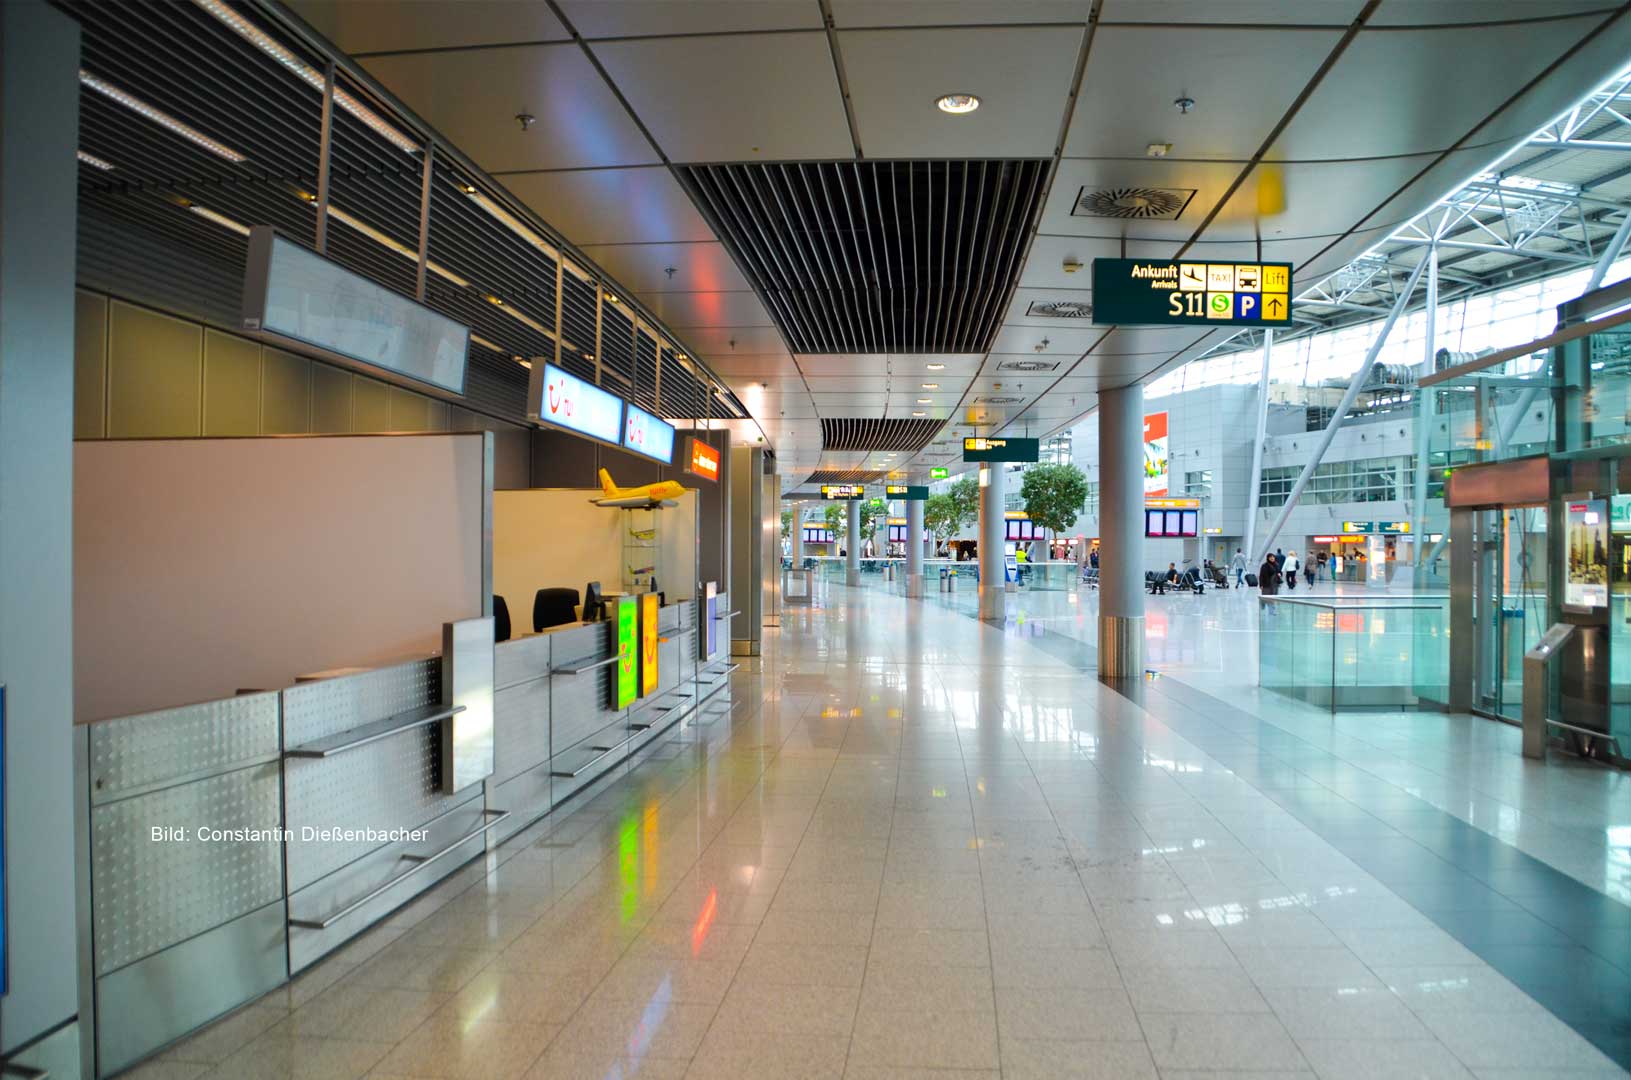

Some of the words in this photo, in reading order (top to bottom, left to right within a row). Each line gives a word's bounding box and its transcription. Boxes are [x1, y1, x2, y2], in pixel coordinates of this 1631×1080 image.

[1131, 264, 1178, 279] Ankunft
[1211, 273, 1231, 283] TAXI
[1151, 280, 1178, 289] Arrivals
[1265, 272, 1285, 286] Lift
[1241, 295, 1255, 317] P
